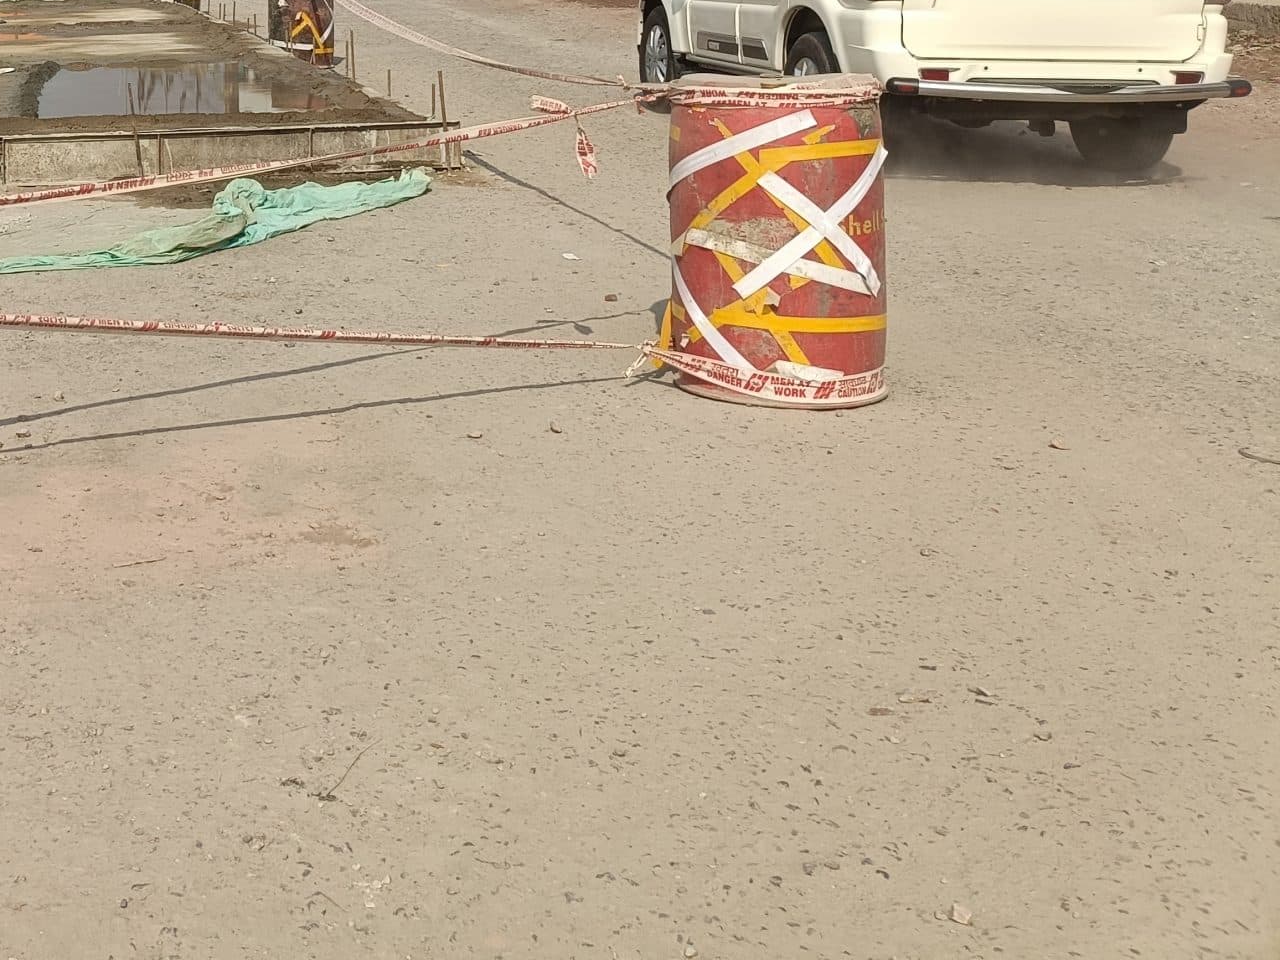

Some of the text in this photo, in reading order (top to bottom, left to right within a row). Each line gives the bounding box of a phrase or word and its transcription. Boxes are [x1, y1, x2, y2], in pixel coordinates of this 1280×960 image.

[842, 212, 882, 237] hell
[706, 370, 743, 389] DANGER
[774, 386, 807, 398] WORK
